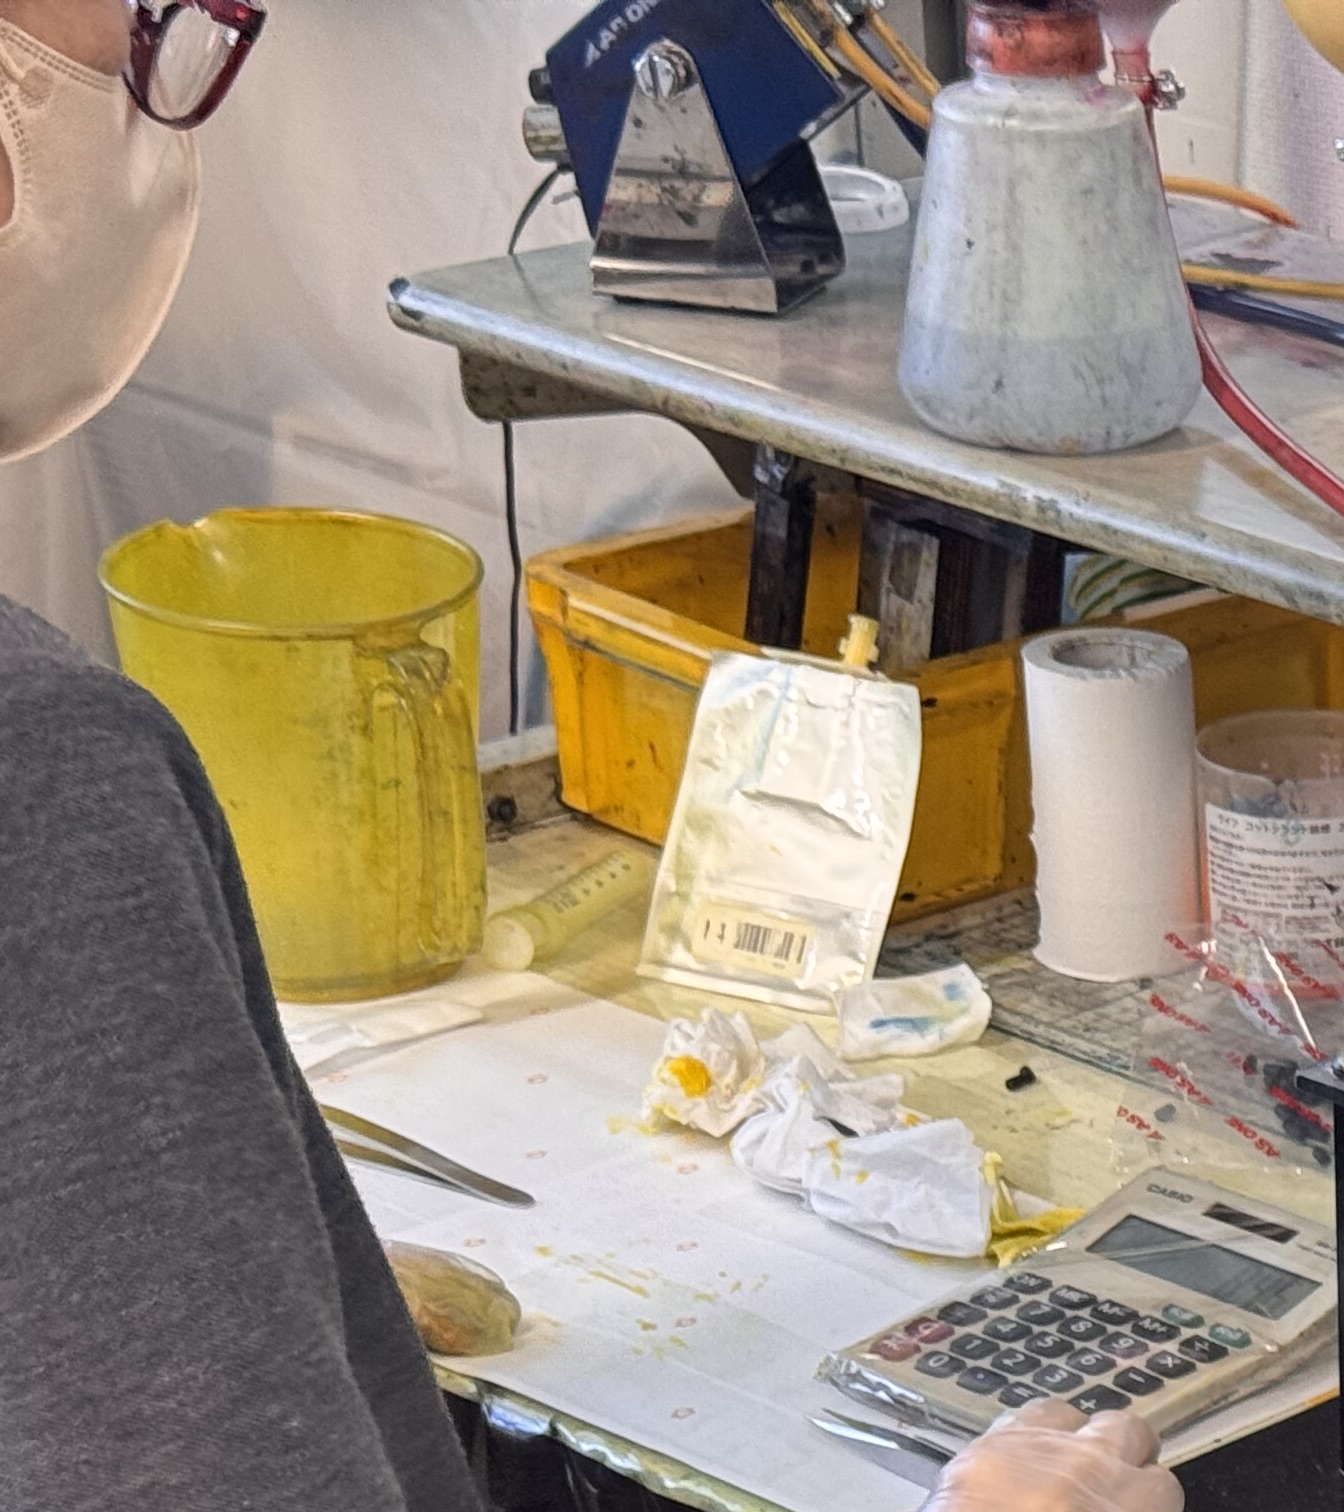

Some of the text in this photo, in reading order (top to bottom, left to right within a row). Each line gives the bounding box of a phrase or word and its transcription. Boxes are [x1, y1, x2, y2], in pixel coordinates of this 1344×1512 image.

[1255, 1136, 1280, 1158] AS
[1146, 1183, 1194, 1203] CASIO
[1030, 1303, 1049, 1315] 7
[1070, 1320, 1093, 1333] 8
[1036, 1335, 1061, 1348] 5
[1111, 1337, 1135, 1350] 9
[928, 1354, 950, 1368] 0
[1002, 1353, 1026, 1367] 2
[1079, 1352, 1102, 1366] 6
[1045, 1369, 1069, 1383] 3
